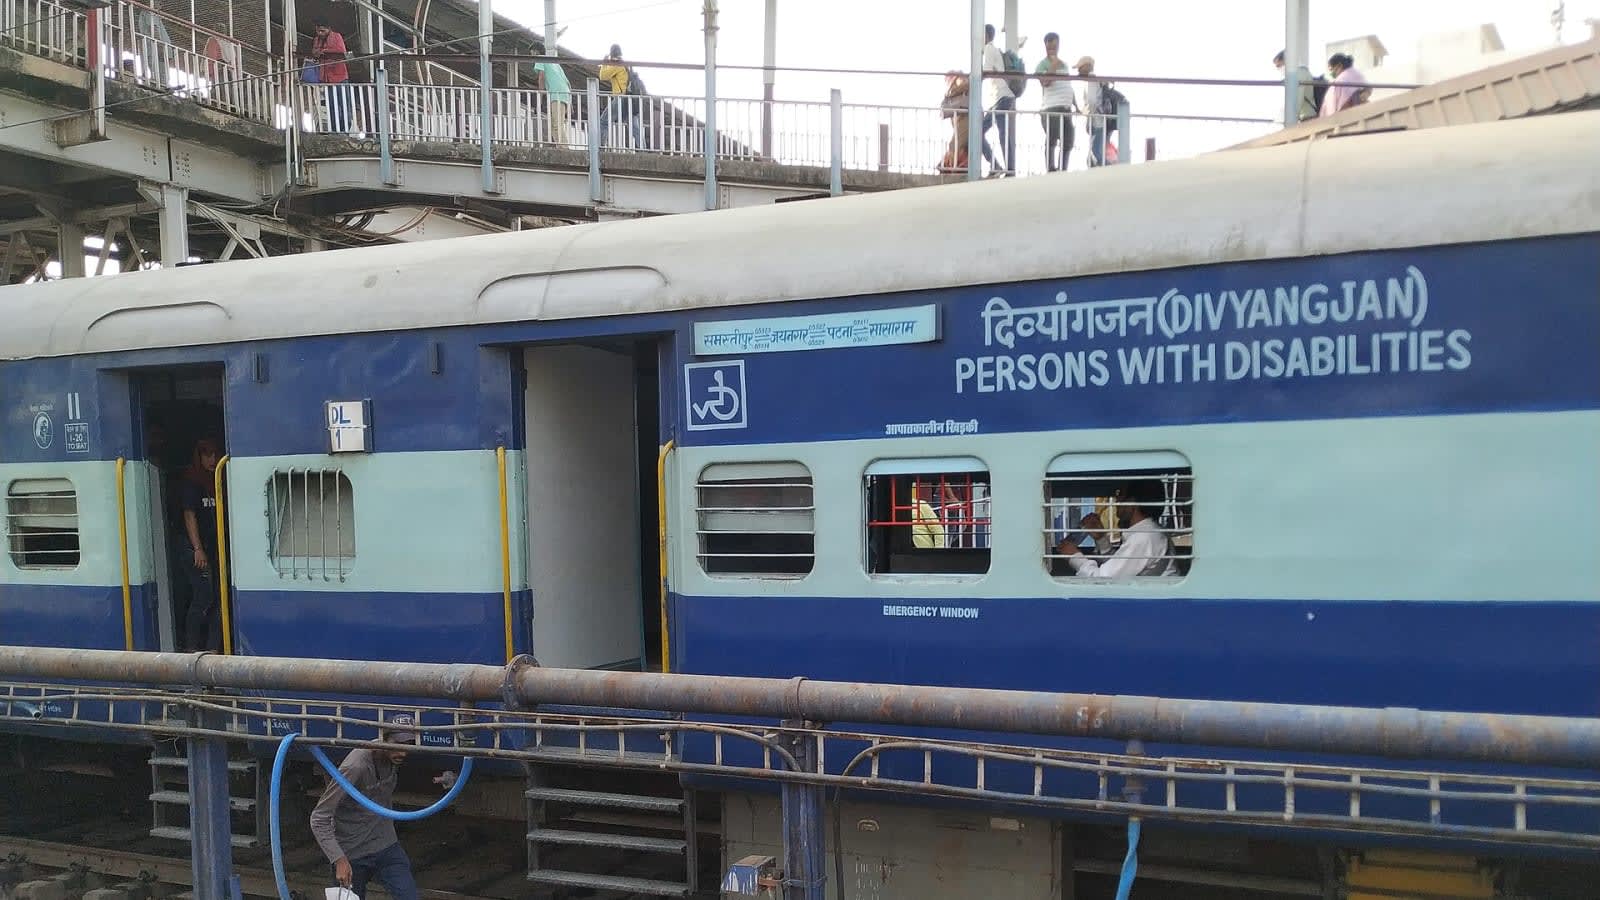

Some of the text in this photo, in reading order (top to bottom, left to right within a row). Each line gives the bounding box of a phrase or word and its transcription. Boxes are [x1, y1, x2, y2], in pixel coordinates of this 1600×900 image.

[704, 320, 917, 350] समस्तीपुर जयनगर पटना सासाराम
[955, 329, 1472, 393] PERSONS WITH DISABILITIES
[331, 405, 351, 424] DL
[885, 420, 945, 435] आपातकालीन
[335, 429, 342, 450] 1
[883, 605, 979, 618] EMERGENCY WINDOW
[422, 734, 451, 745] FILLING
